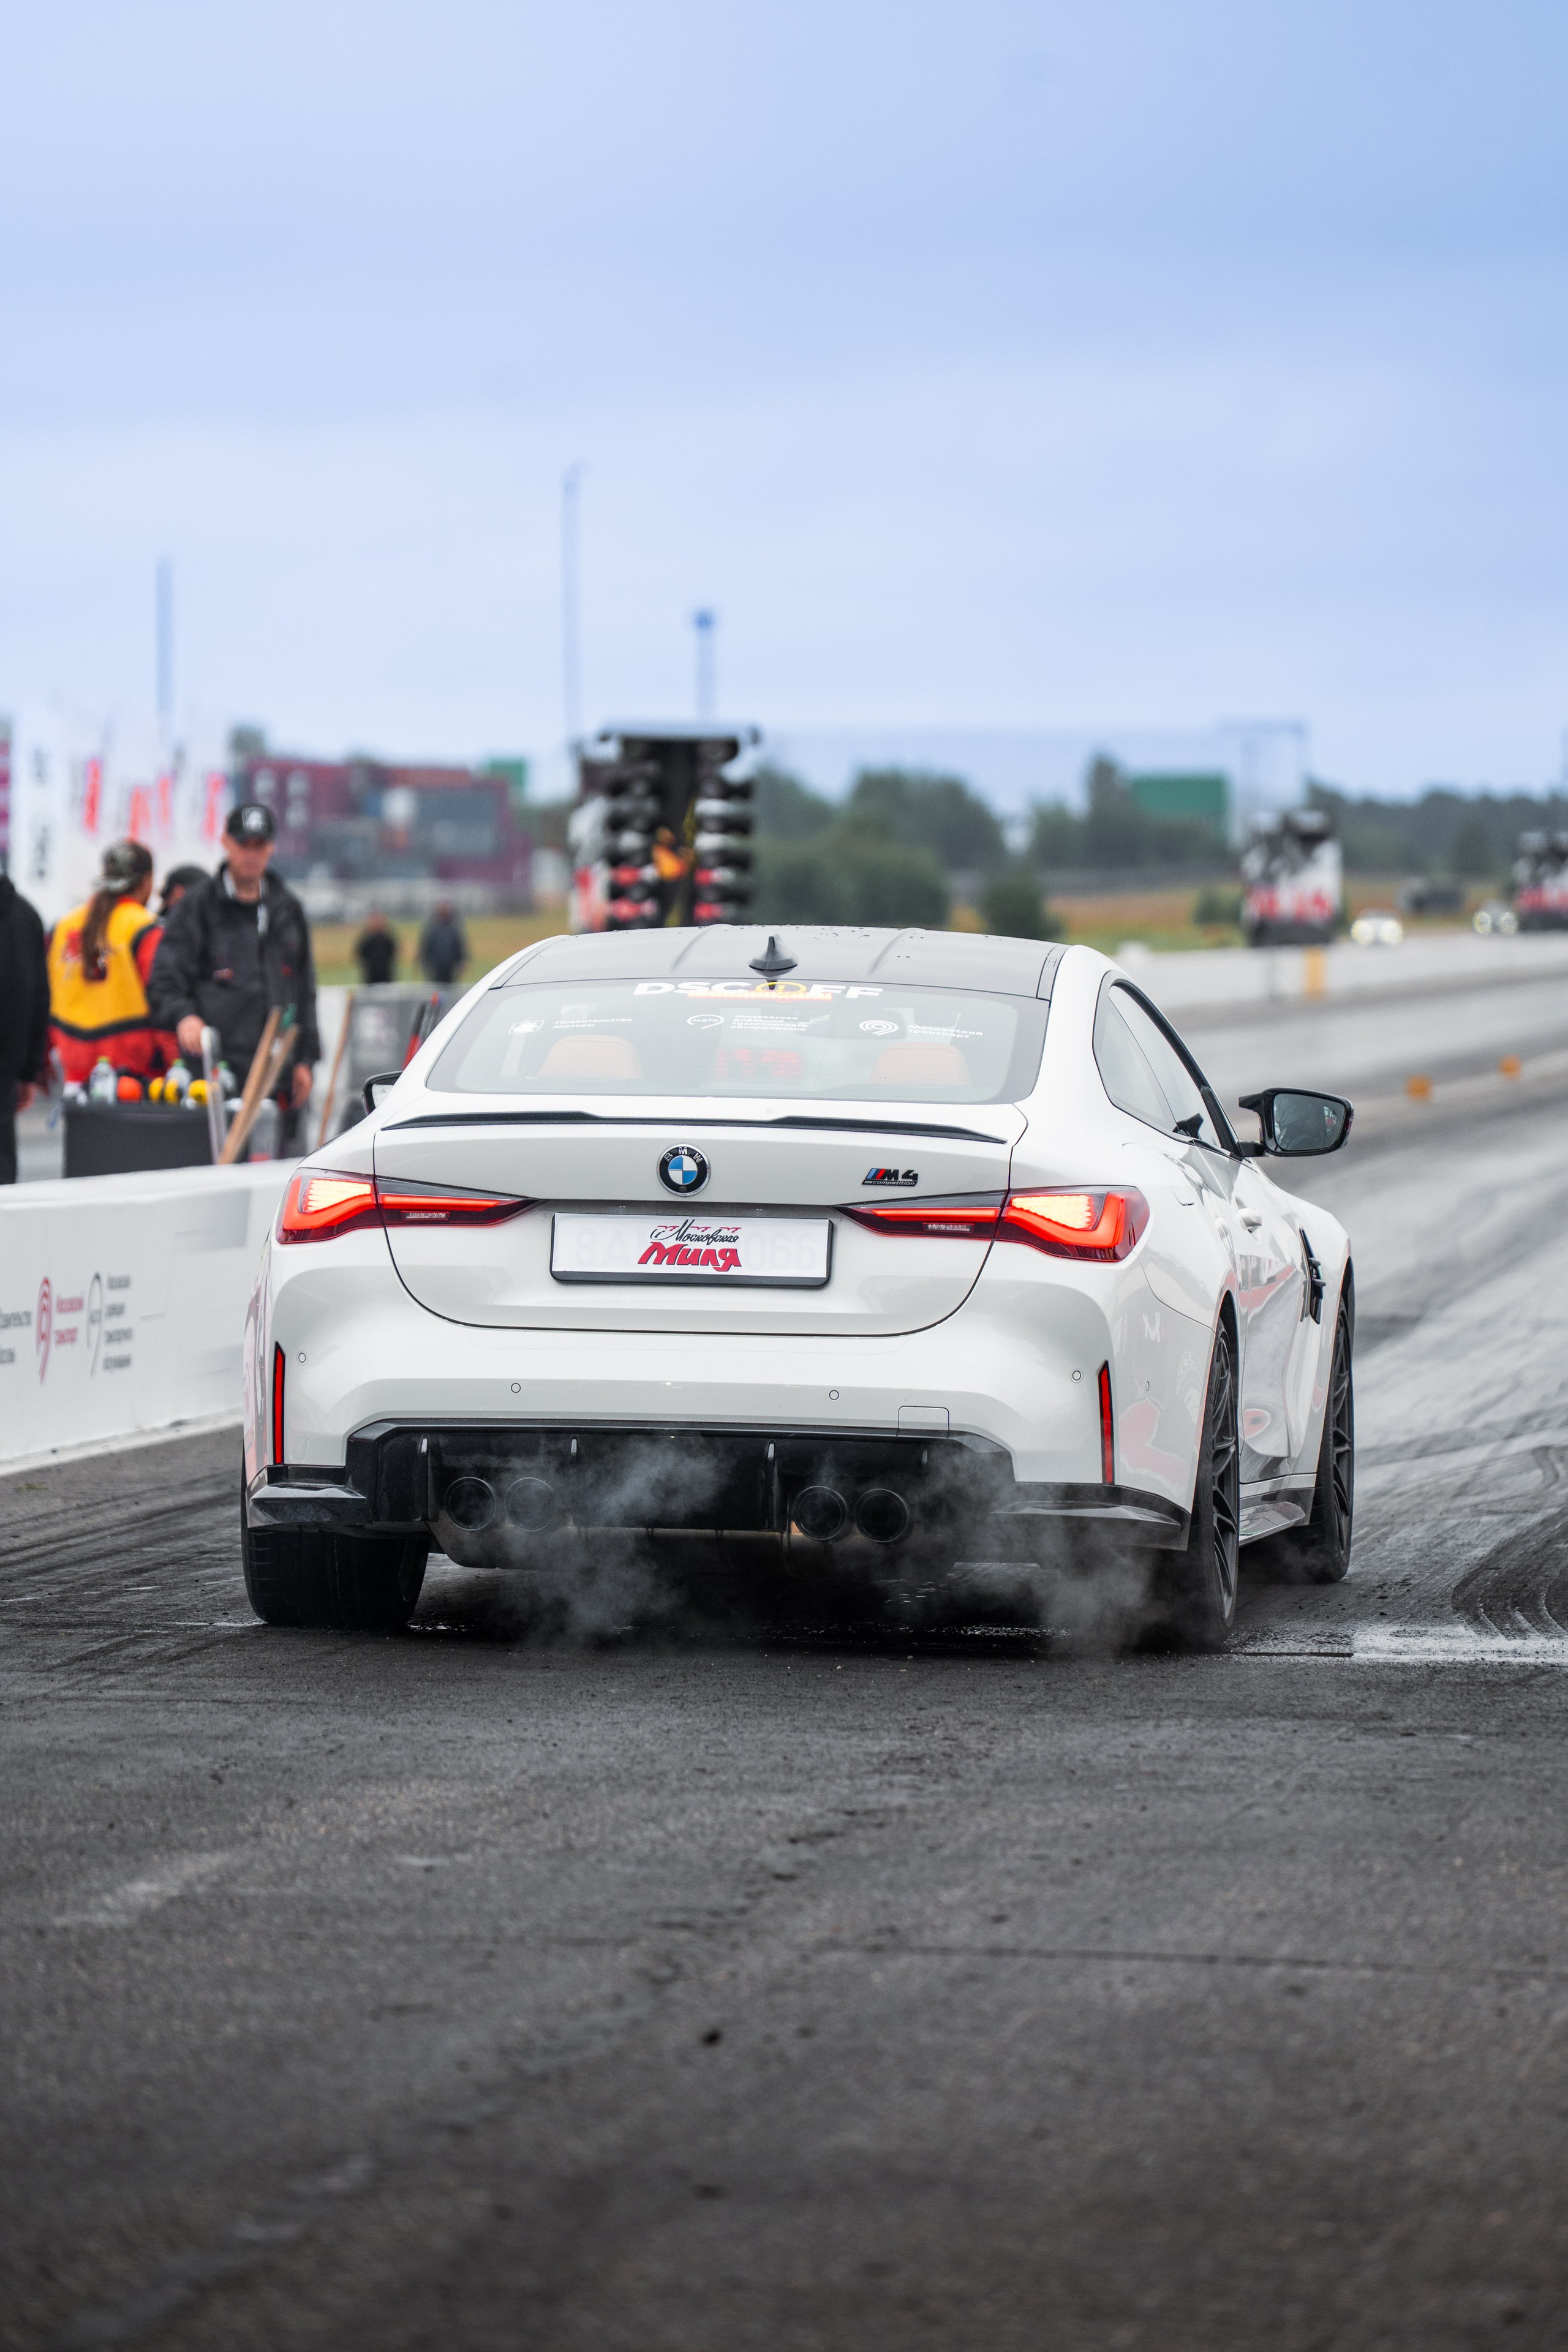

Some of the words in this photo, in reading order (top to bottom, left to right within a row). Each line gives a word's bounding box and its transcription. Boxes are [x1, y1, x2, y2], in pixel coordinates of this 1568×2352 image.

[633, 981, 752, 995] DSC
[908, 1024, 984, 1036] Московский
[908, 1029, 971, 1039] транспорт
[663, 1147, 704, 1163] BMW
[650, 1219, 739, 1245] Московская
[637, 1242, 742, 1272] Миля
